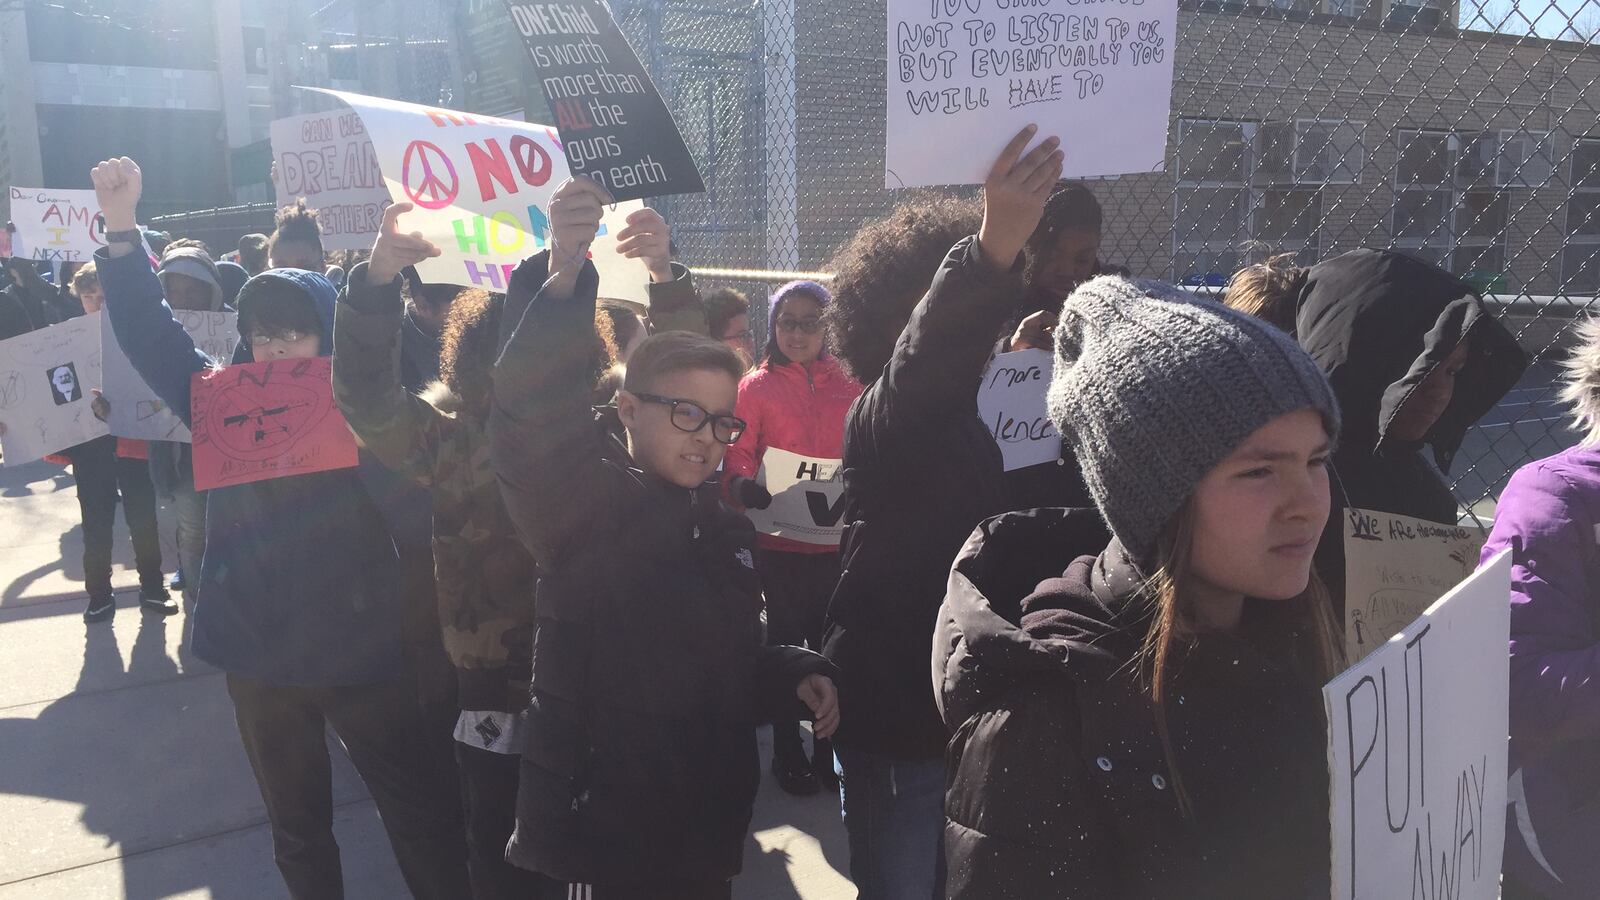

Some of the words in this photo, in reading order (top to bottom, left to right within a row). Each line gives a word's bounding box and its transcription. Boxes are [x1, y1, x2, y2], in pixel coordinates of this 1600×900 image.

[511, 4, 557, 36] ONE
[549, 2, 600, 35] Child
[898, 21, 953, 54] NOT
[963, 20, 996, 46] TO
[1008, 12, 1099, 45] LISTEN
[1105, 18, 1130, 42] TO
[1137, 20, 1164, 47] US,
[526, 39, 550, 67] is
[549, 35, 609, 66] worth
[900, 51, 957, 83] BUT
[972, 44, 1122, 78] EVENTUALLY
[1130, 42, 1164, 66] YOU
[543, 74, 600, 99] more
[596, 66, 646, 94] than
[906, 87, 989, 115] WILL
[1008, 75, 1062, 106] HAVE
[1073, 70, 1104, 99] TO
[302, 119, 333, 143] CAN
[338, 113, 364, 138] WE
[555, 100, 592, 131] ALL
[588, 97, 627, 127] the
[464, 134, 553, 203] NO
[567, 135, 621, 170] guns
[610, 154, 667, 188] earth
[47, 228, 69, 245] I
[33, 247, 80, 262] NEXT?
[1350, 512, 1380, 535] We
[1346, 623, 1431, 900] PUT
